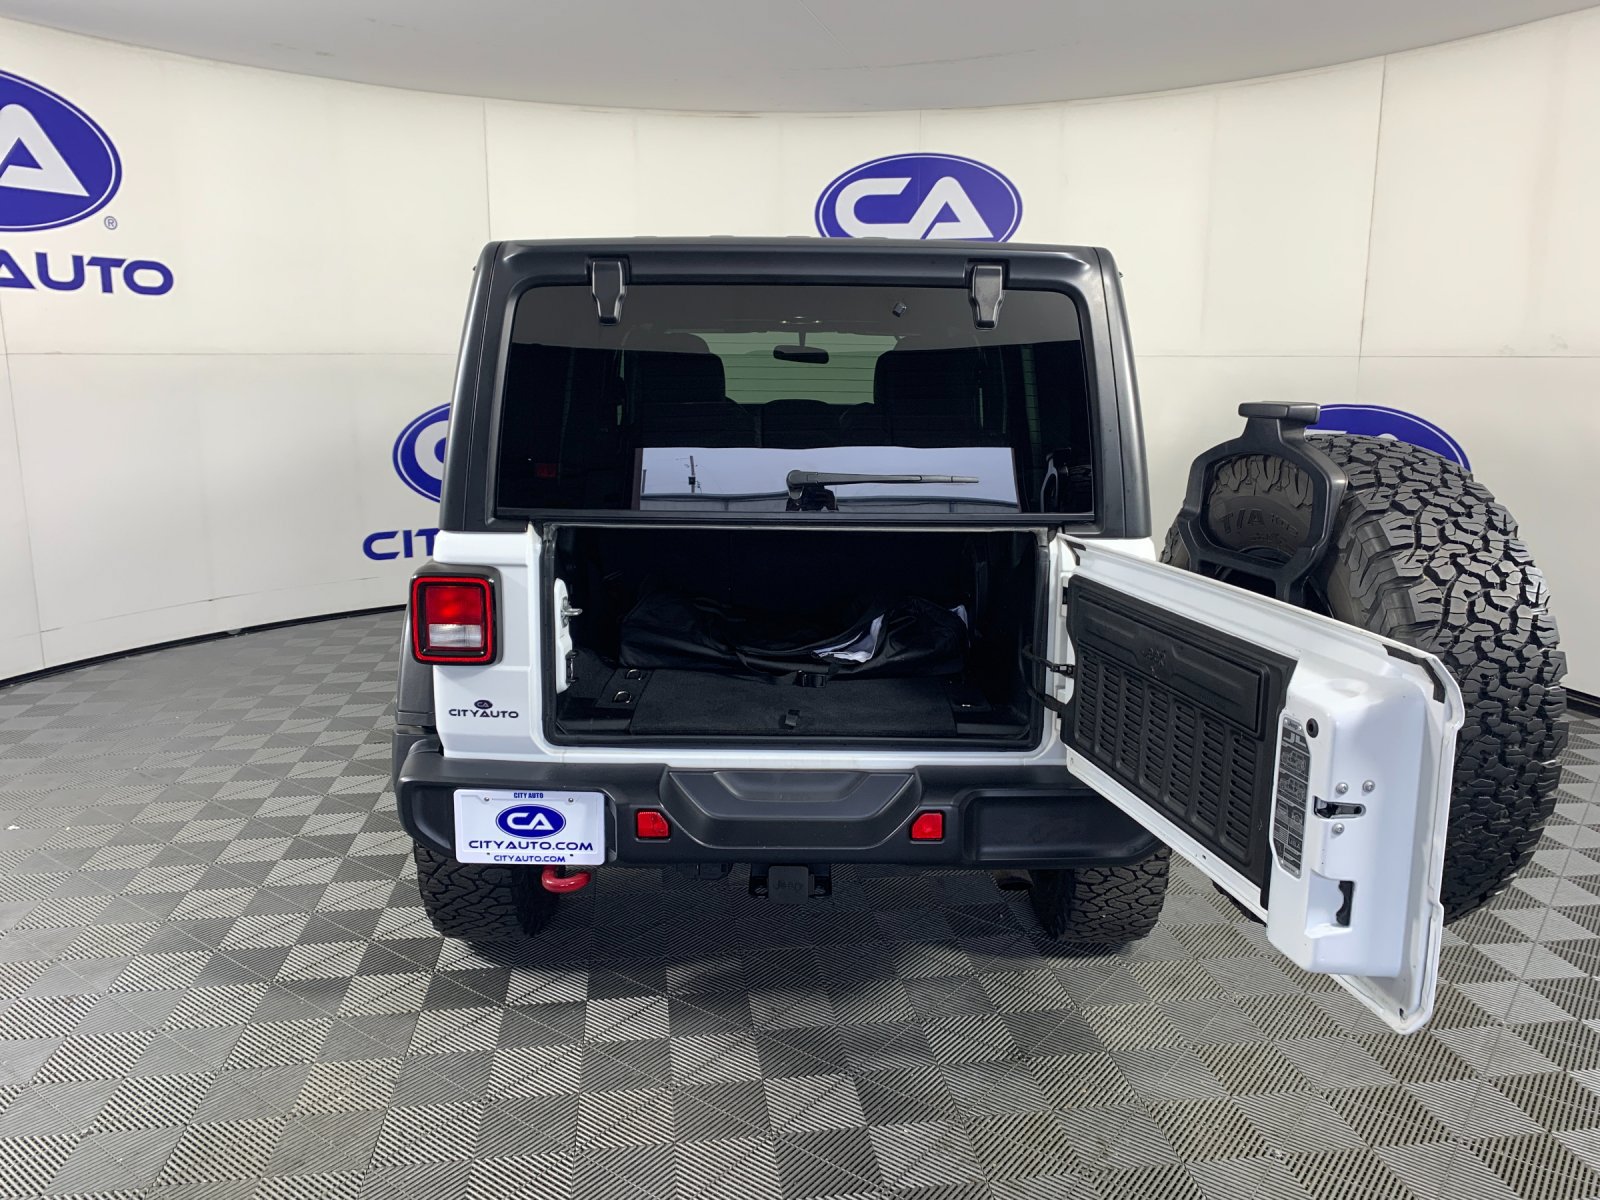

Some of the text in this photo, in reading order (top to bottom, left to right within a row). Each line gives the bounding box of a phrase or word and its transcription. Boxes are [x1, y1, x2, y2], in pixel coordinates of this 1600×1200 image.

[835, 176, 994, 239] CA
[448, 709, 519, 718] CITYAUTO
[506, 812, 555, 831] CA
[468, 840, 593, 851] CITYAUTO.COM
[493, 855, 566, 863] CITYAUTO.COM
